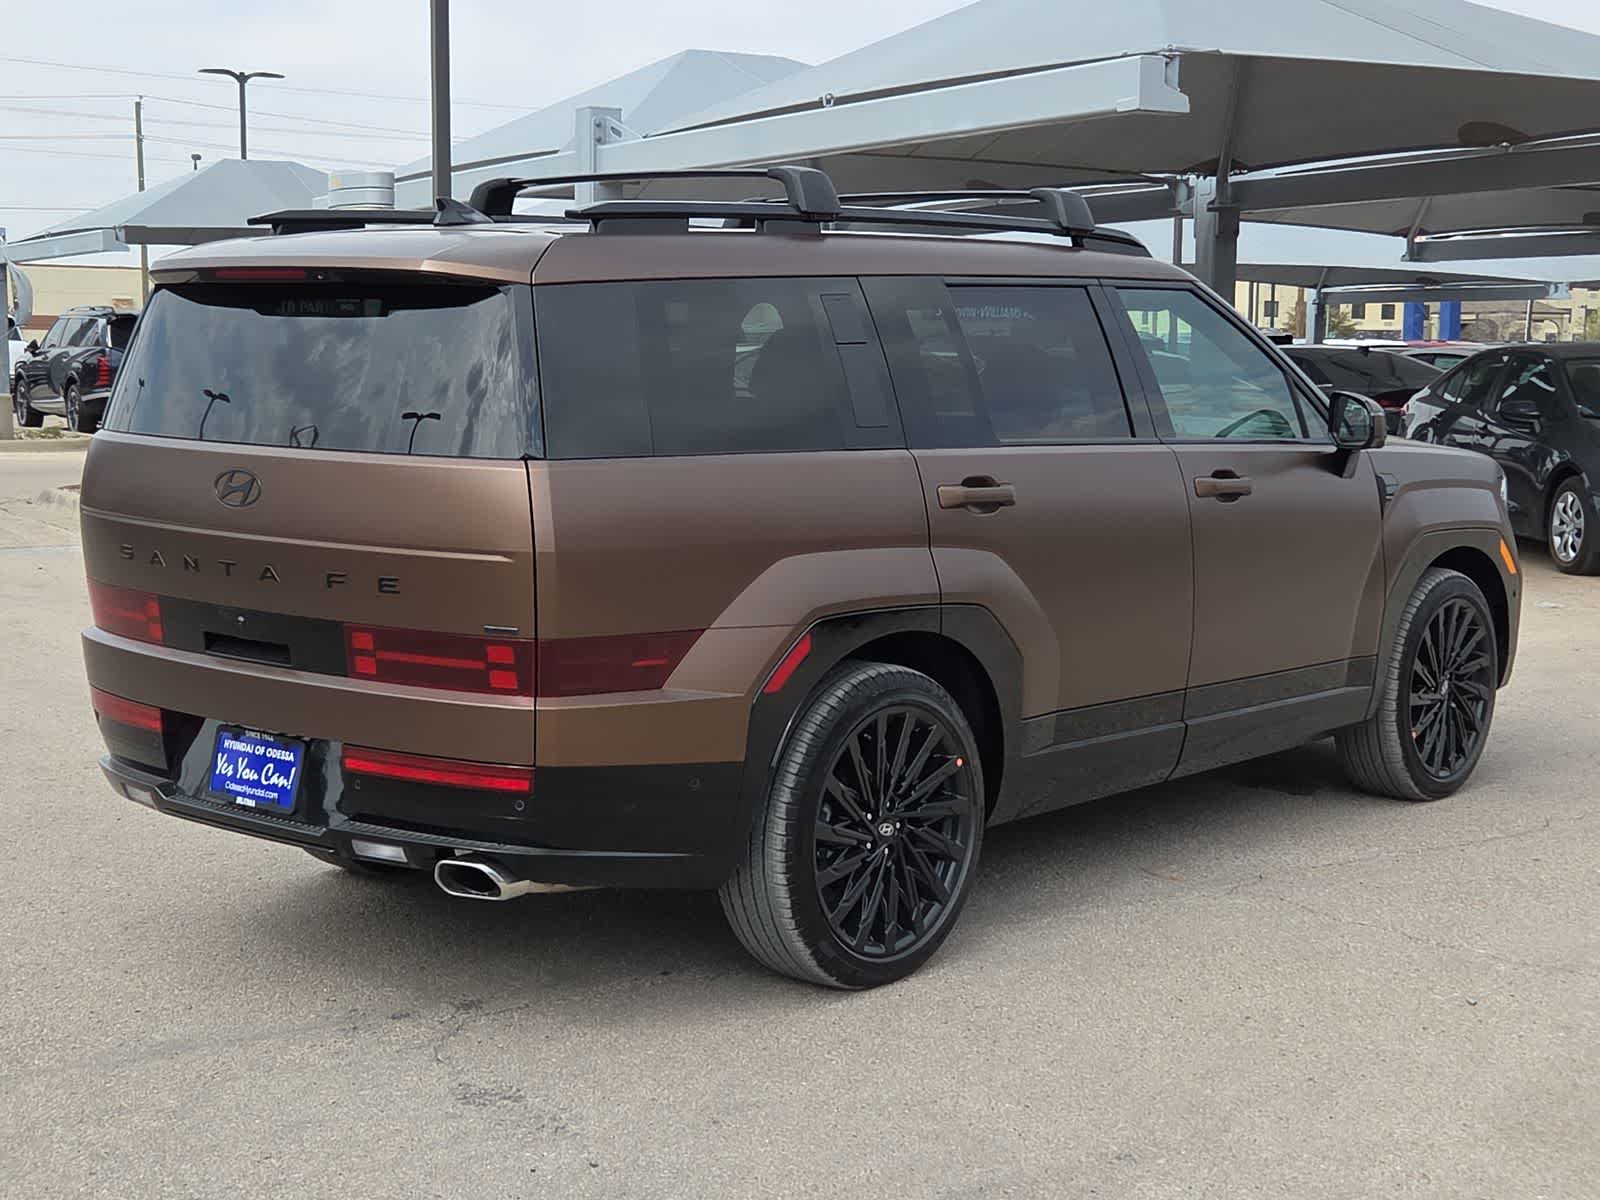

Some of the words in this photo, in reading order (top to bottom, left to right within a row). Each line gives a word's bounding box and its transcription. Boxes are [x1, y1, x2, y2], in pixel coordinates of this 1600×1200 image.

[120, 543, 281, 583] SANTA
[325, 571, 401, 594] FE
[223, 739, 254, 753] HYUNDAI
[254, 745, 265, 756] OF
[265, 748, 295, 762] ODESSA
[215, 752, 234, 777] Yes
[236, 757, 259, 781] You
[260, 763, 297, 790] Can!
